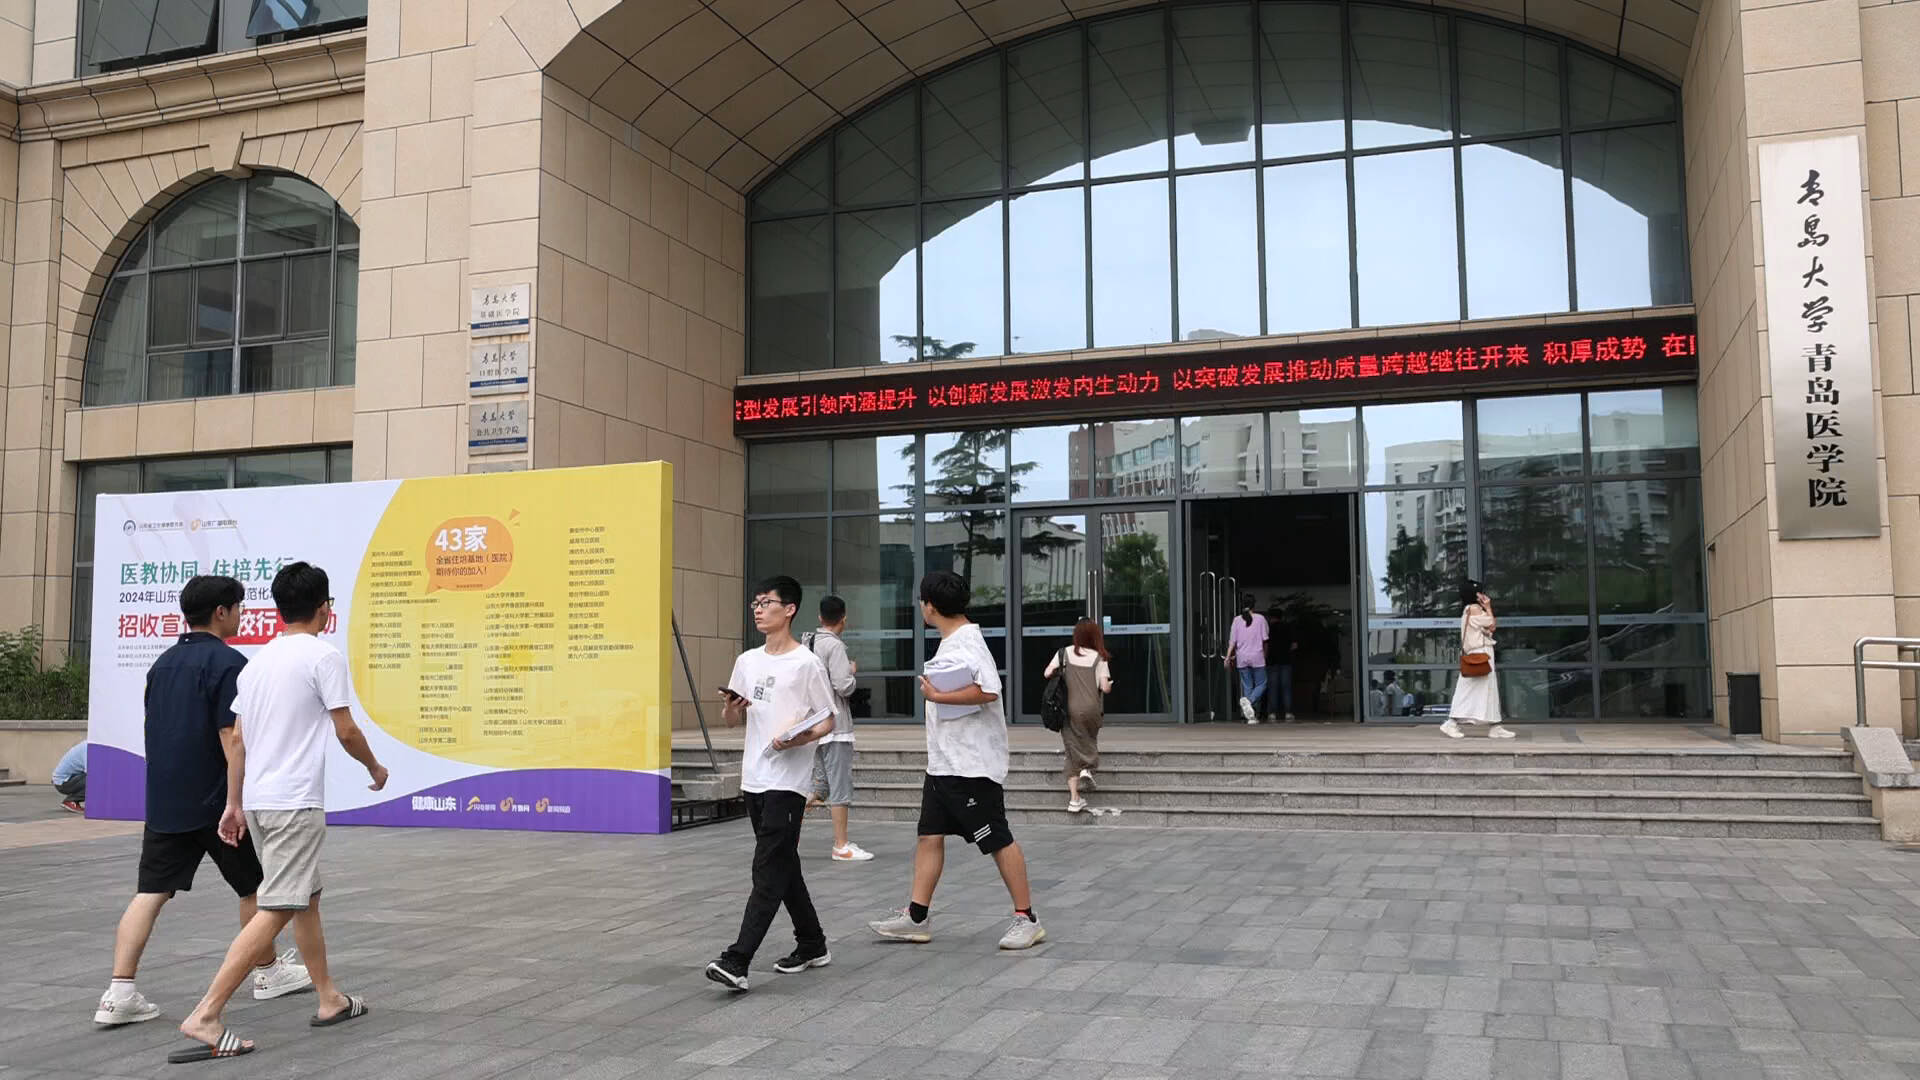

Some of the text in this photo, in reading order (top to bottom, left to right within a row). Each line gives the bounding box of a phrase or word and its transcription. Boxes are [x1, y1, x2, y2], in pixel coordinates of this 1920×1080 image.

[928, 371, 1161, 408] 以创新发展激发内生动力
[1172, 344, 1530, 391] 以突破发展推动质量跨越继往开来
[1543, 335, 1647, 366] 积厚成势
[1661, 332, 1697, 357] 在
[434, 524, 488, 552] 43家
[120, 559, 199, 585] 医教协同
[411, 796, 457, 811] 健康山东
